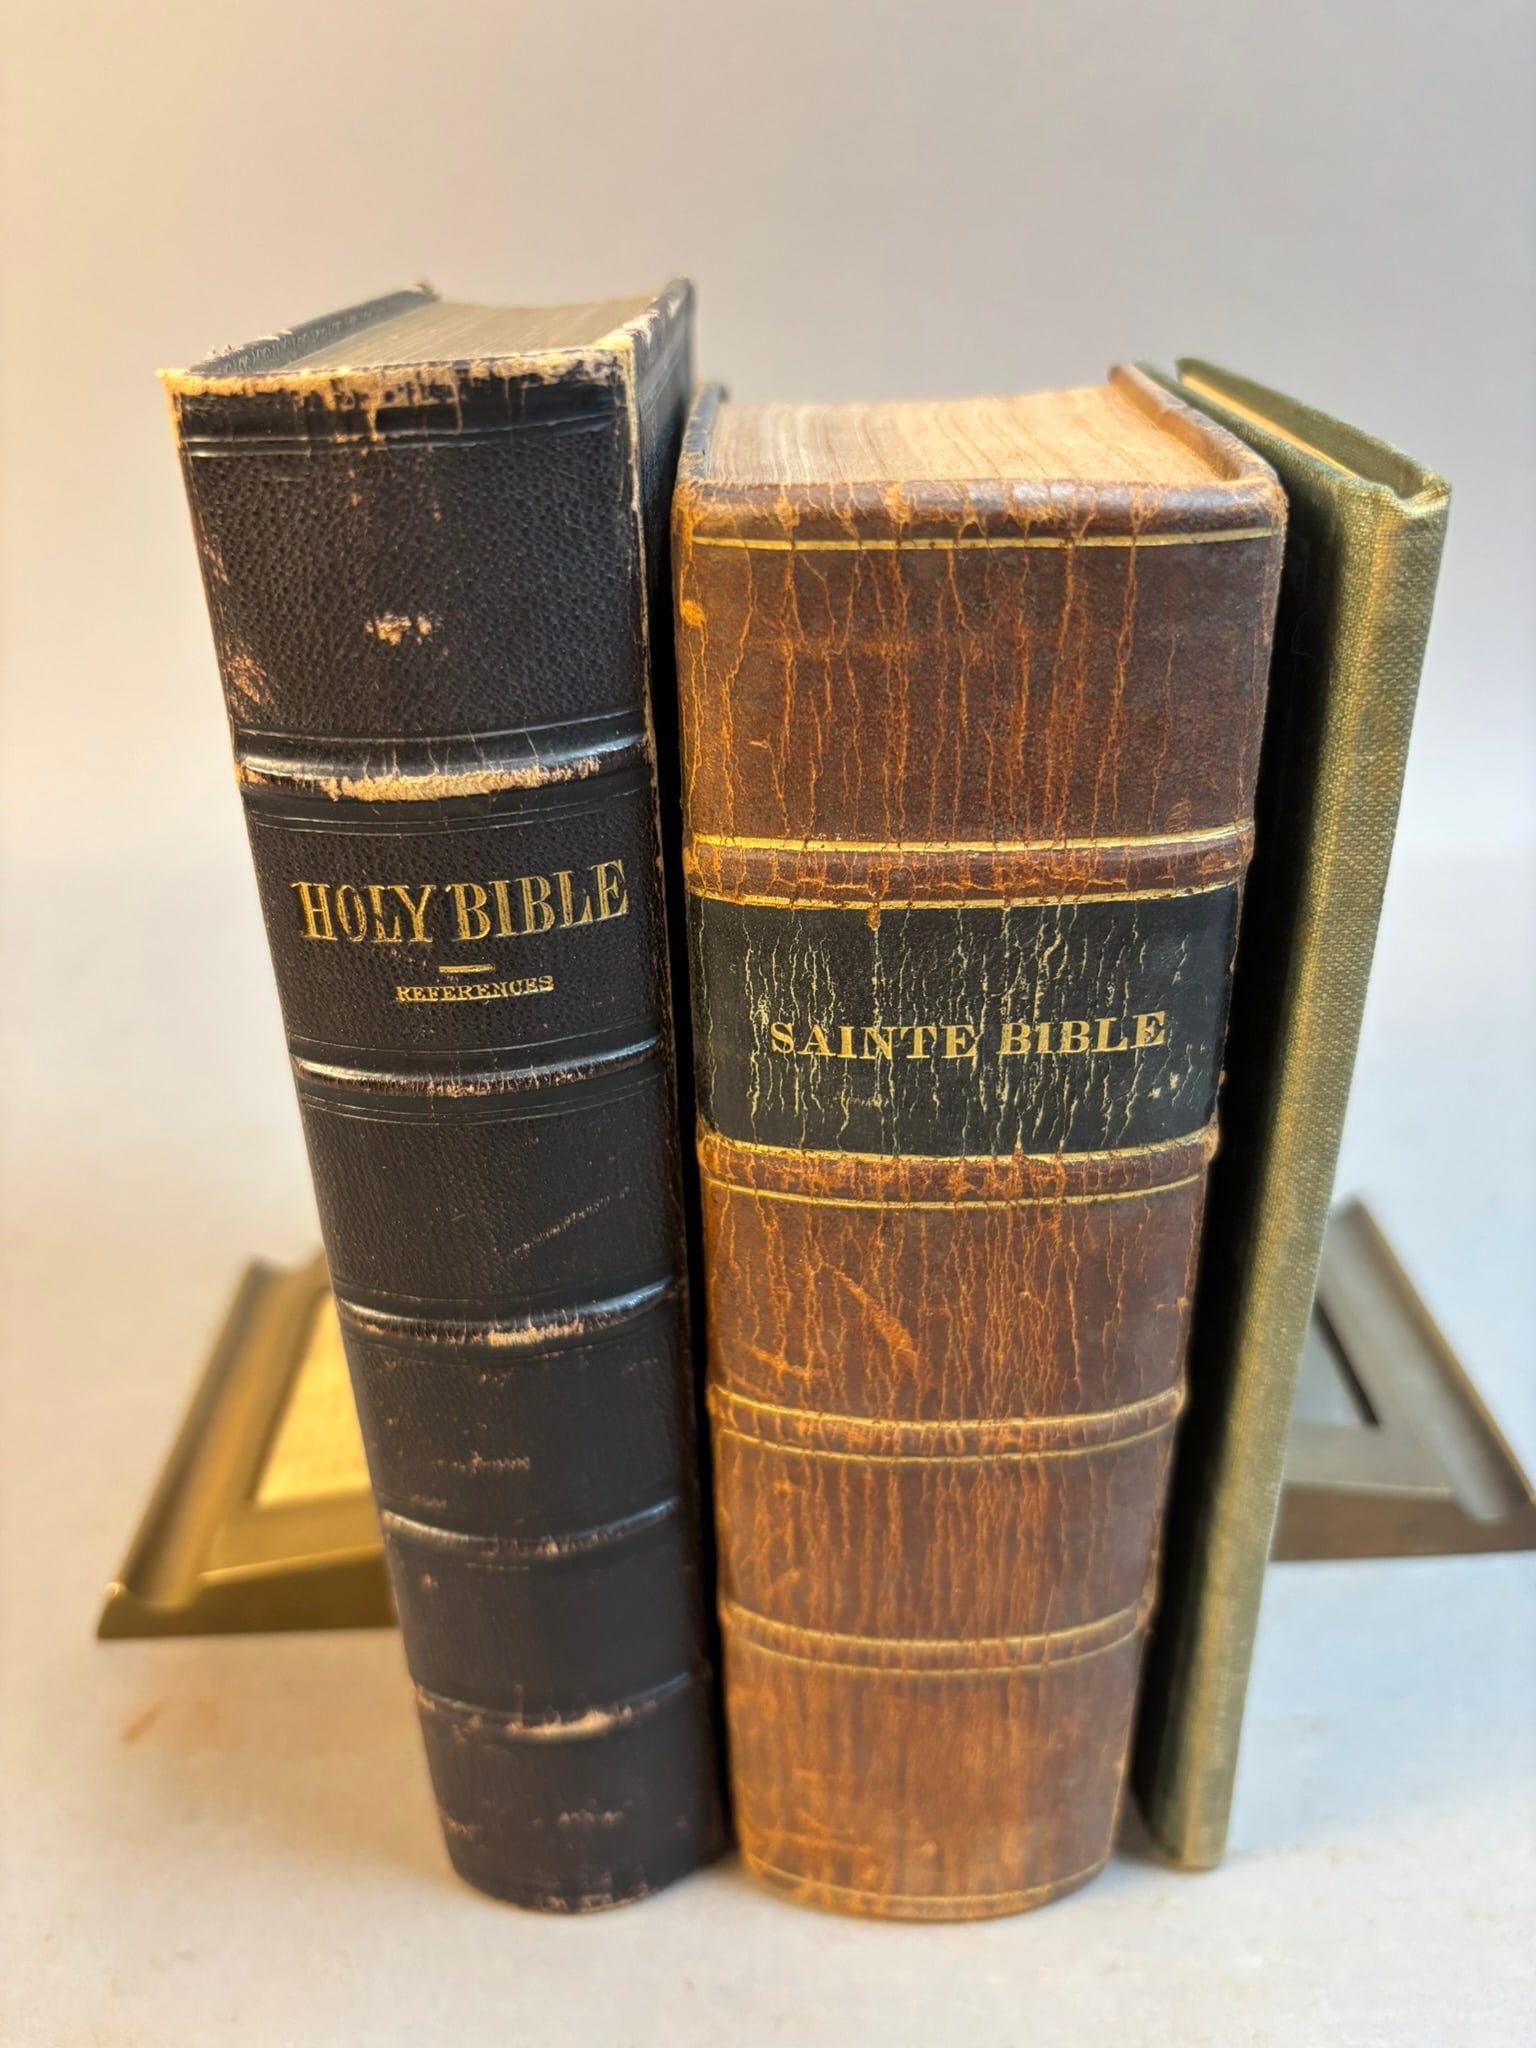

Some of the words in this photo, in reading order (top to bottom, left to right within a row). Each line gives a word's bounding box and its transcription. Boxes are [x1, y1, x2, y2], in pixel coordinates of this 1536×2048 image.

[291, 881, 436, 943] HOLY
[445, 859, 629, 942] BIBLE
[395, 975, 554, 1002] REFERENCES
[769, 1021, 977, 1060] SAINTE
[995, 1010, 1166, 1056] BIBLE
